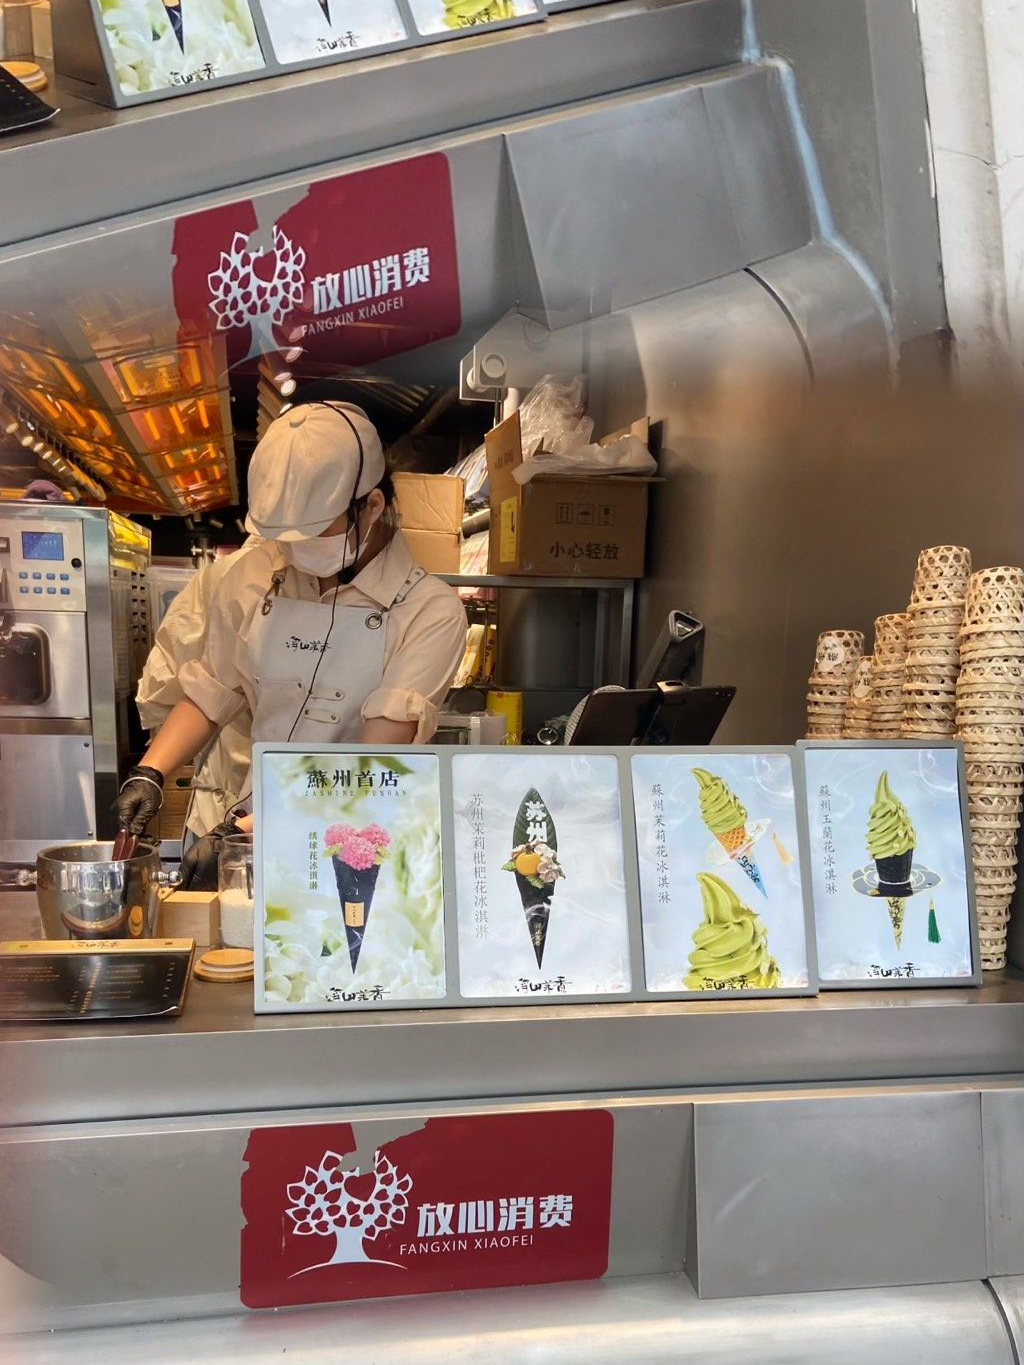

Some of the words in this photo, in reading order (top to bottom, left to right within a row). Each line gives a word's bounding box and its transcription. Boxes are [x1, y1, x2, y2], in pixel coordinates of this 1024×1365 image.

[310, 246, 431, 315] 放心消费
[301, 308, 355, 338] FANGXIN
[358, 295, 405, 324] XIAOFEI
[549, 540, 620, 561] 小心轻放
[524, 800, 548, 844] 苏州
[416, 1194, 575, 1238] 放心消费
[399, 1238, 468, 1257] FANGXIN
[474, 1234, 535, 1251] XIAOFEI
